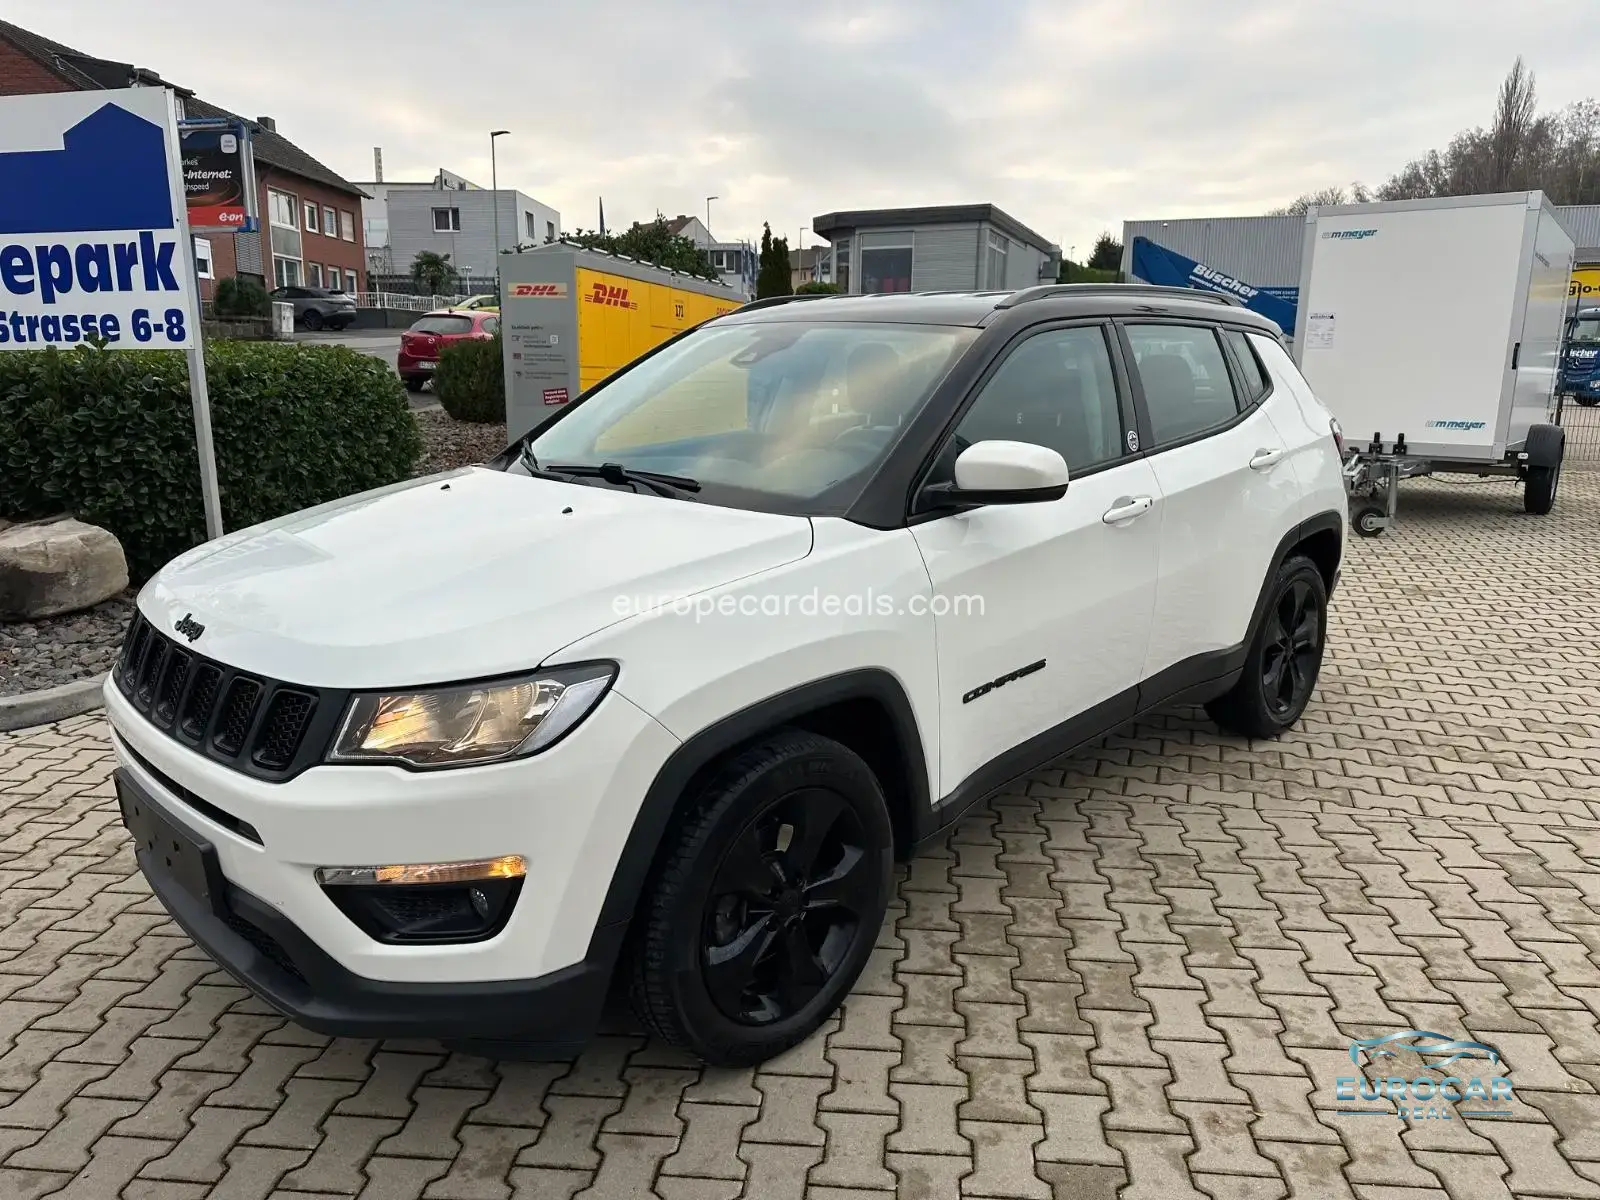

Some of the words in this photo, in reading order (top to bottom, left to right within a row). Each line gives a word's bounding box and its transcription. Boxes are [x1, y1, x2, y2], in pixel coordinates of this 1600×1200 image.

[183, 170, 232, 179] -Internet:
[0, 231, 180, 304] epark
[1193, 264, 1259, 298] Büscher
[516, 285, 560, 296] DHL
[592, 283, 631, 309] DHL
[131, 308, 186, 342] 6-8
